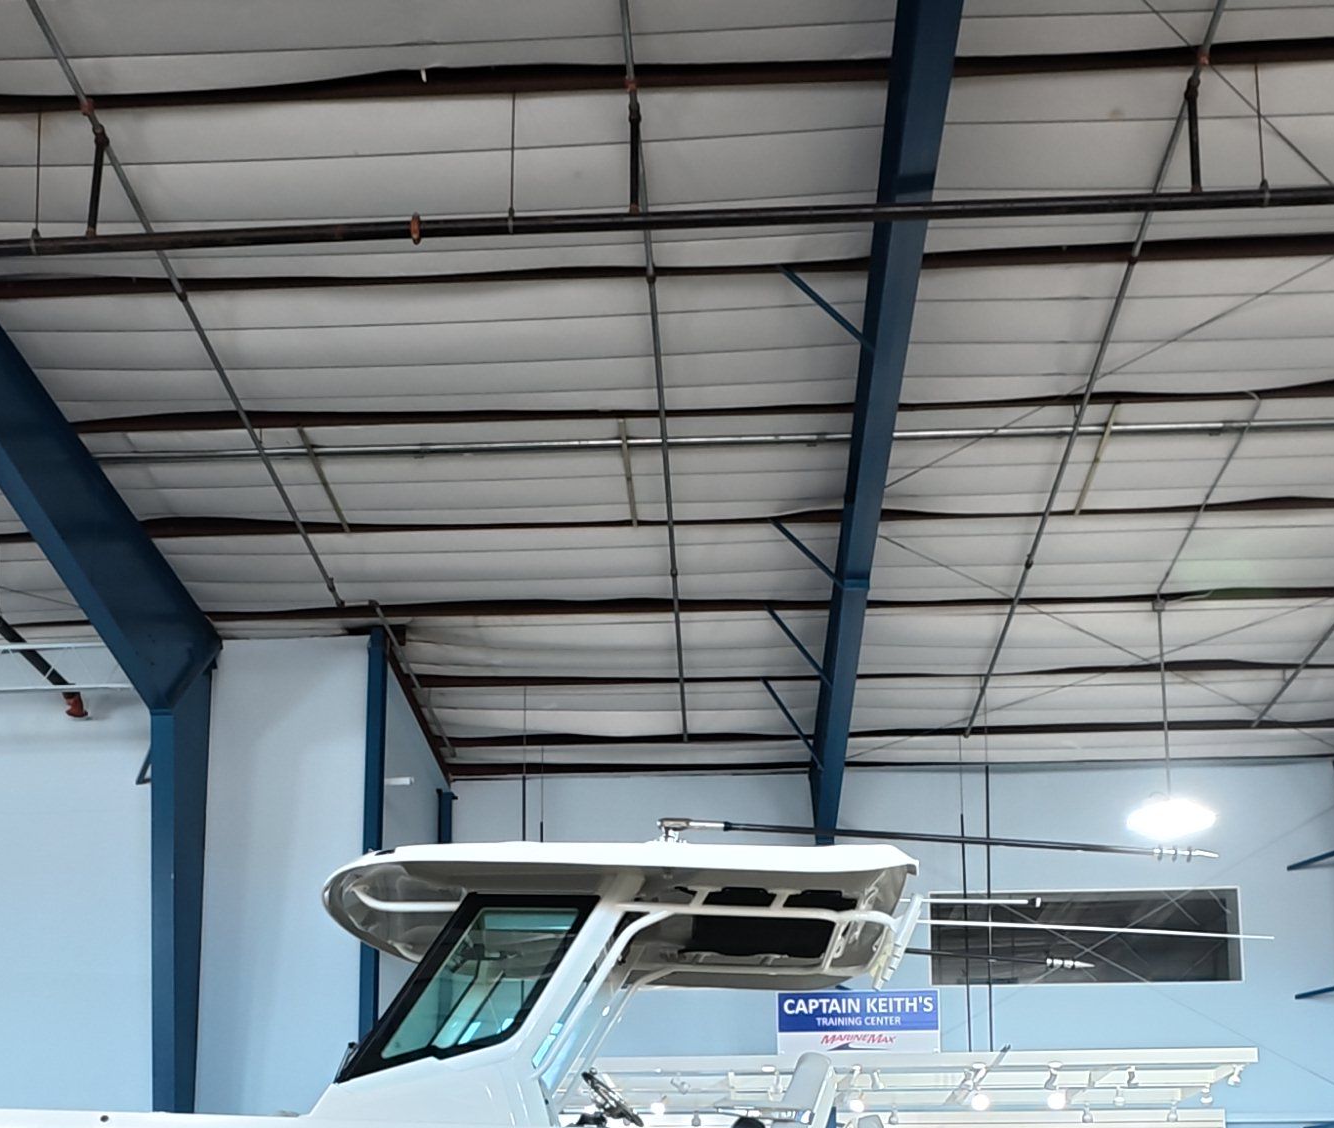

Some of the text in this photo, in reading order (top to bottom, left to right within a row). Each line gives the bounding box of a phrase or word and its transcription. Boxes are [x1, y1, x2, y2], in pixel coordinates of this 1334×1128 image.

[783, 996, 934, 1014] CAPTAIN KEITH'S
[816, 1016, 901, 1026] TRAINING CENTER
